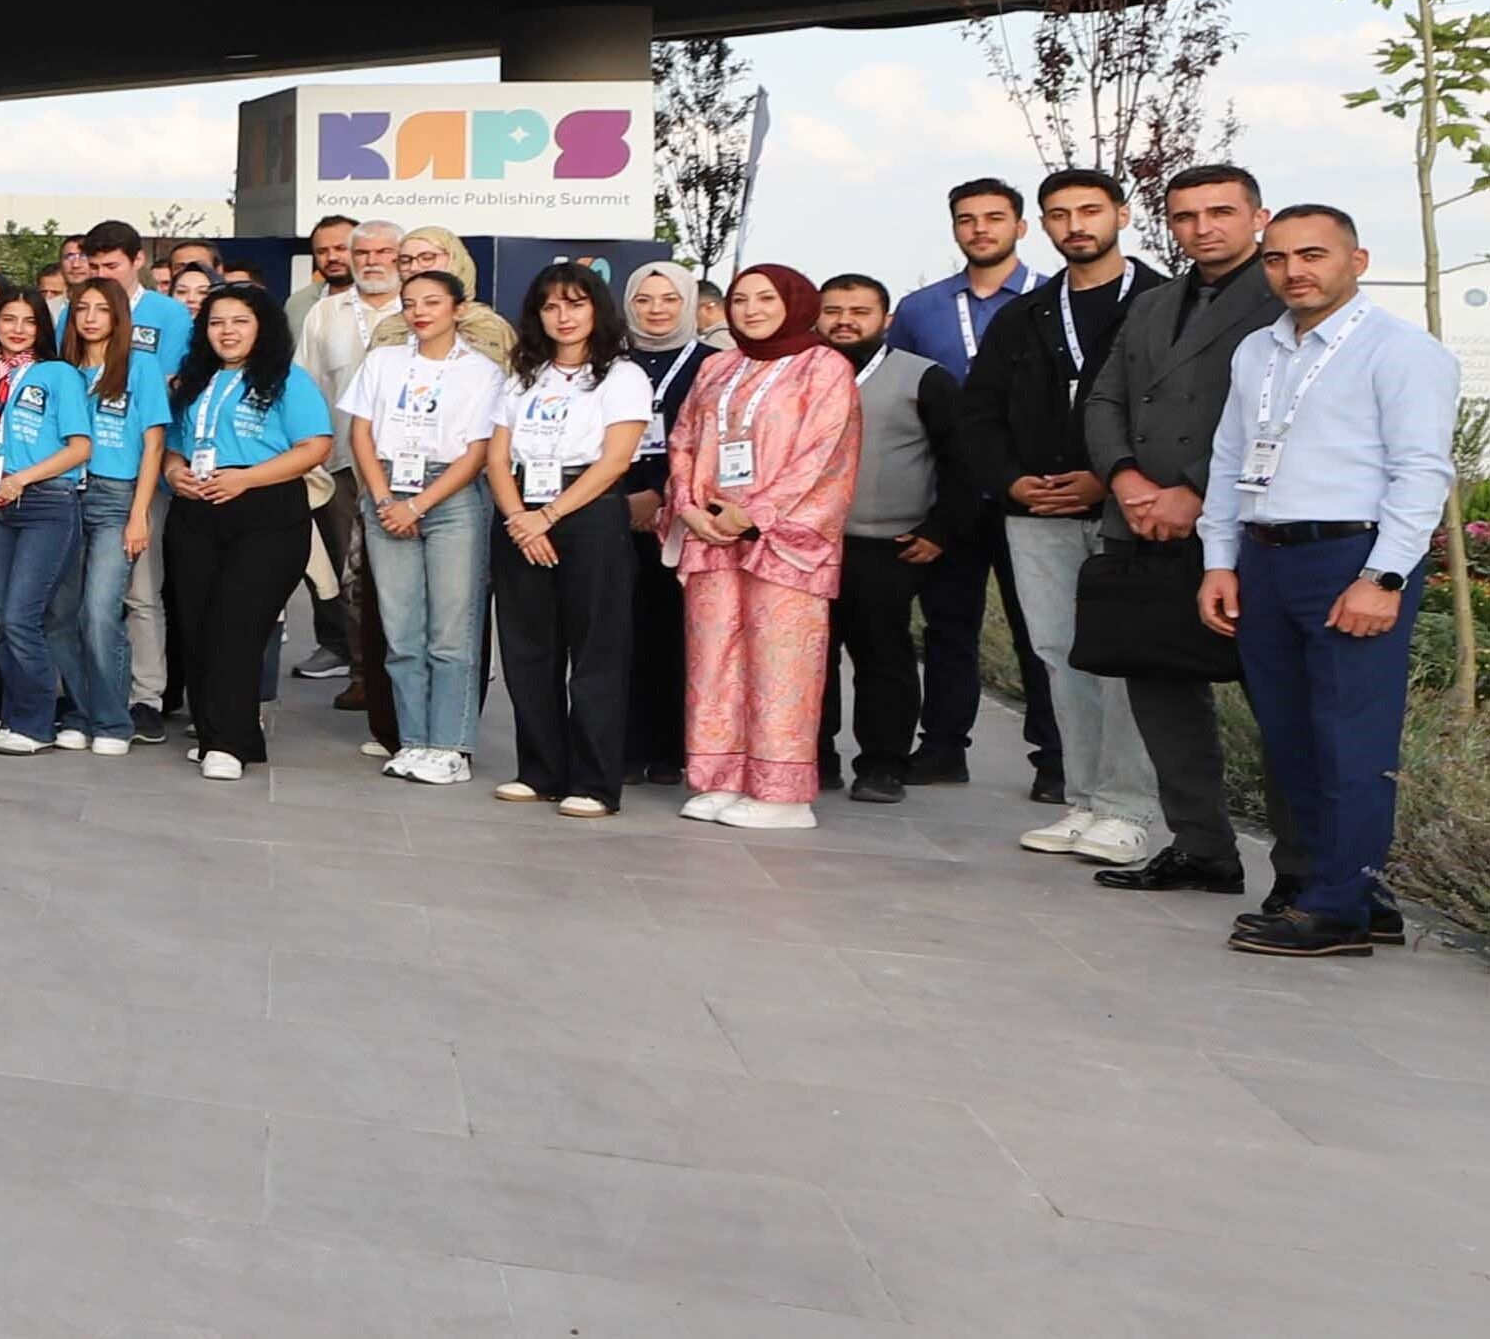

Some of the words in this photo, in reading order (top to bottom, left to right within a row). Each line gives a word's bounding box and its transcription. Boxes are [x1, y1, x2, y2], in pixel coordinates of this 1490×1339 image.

[317, 108, 632, 181] KAPS
[316, 192, 370, 208] Konya
[373, 191, 460, 207] Academic
[464, 191, 556, 208] Publishing
[559, 192, 631, 207] Summit
